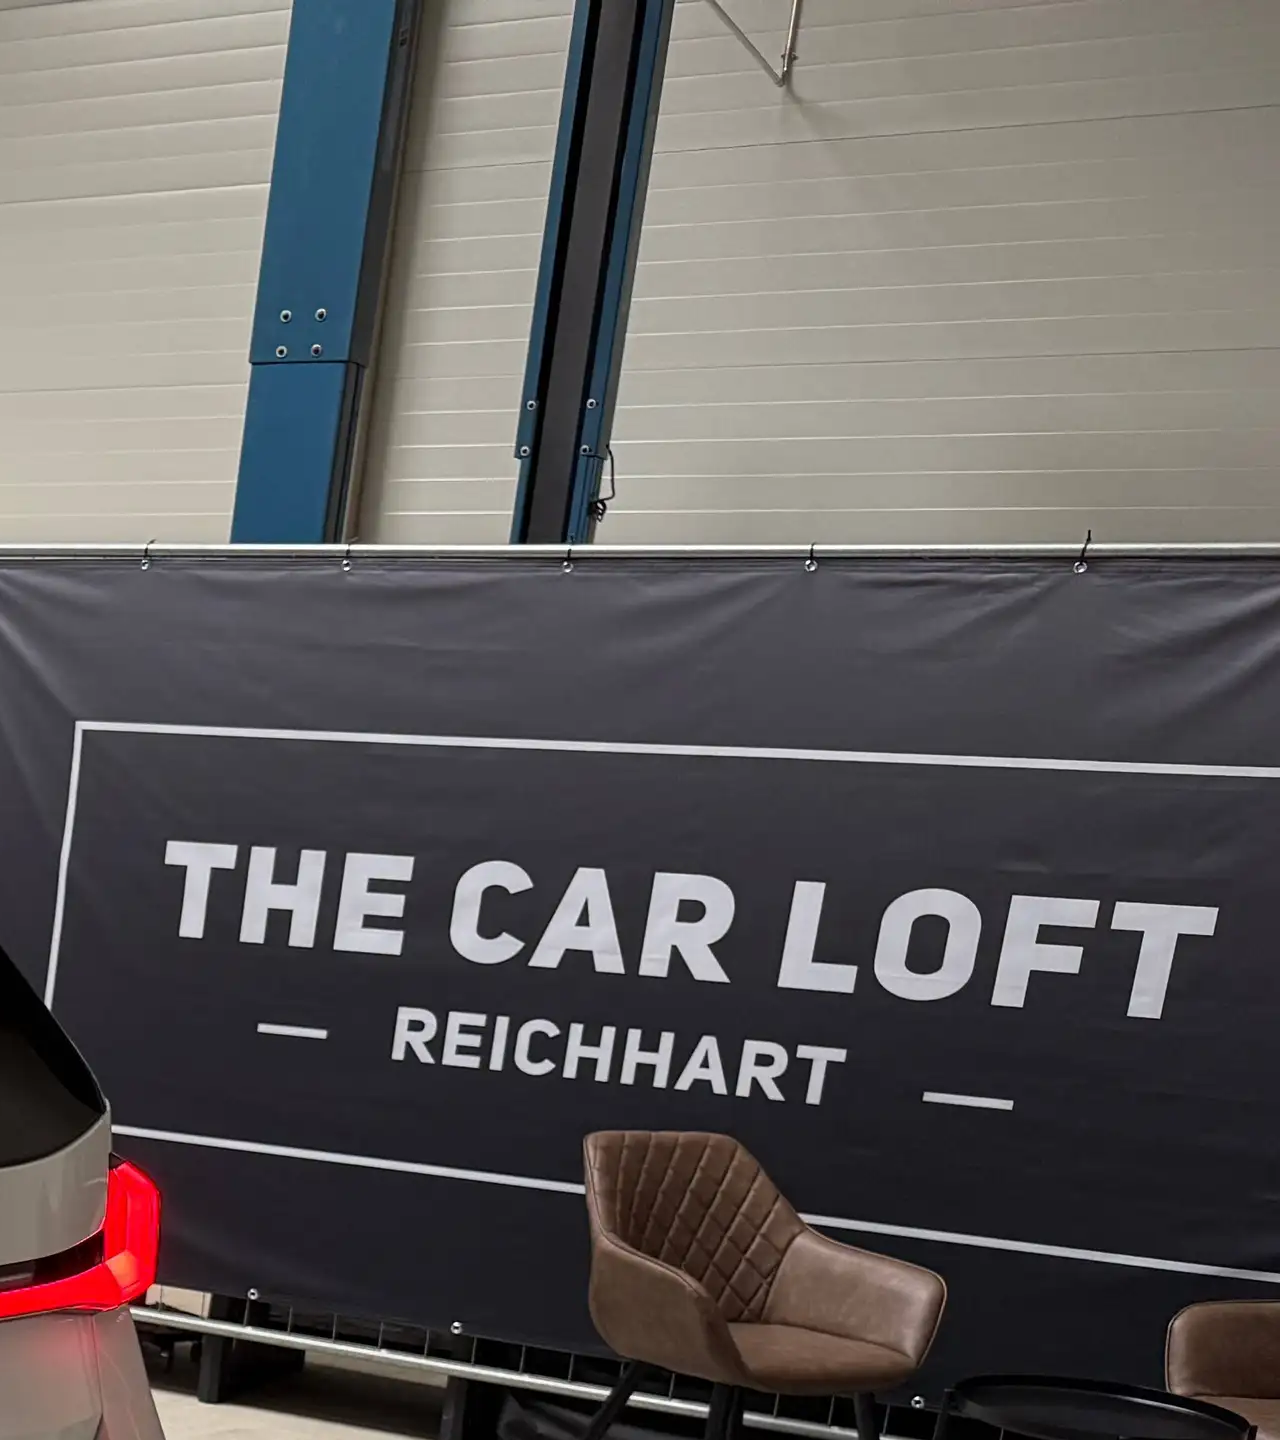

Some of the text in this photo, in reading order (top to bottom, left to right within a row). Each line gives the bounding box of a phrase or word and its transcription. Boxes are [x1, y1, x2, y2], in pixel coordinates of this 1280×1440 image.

[164, 840, 1220, 1020] THE CAR LOFT
[391, 1006, 847, 1105] REICHHART
